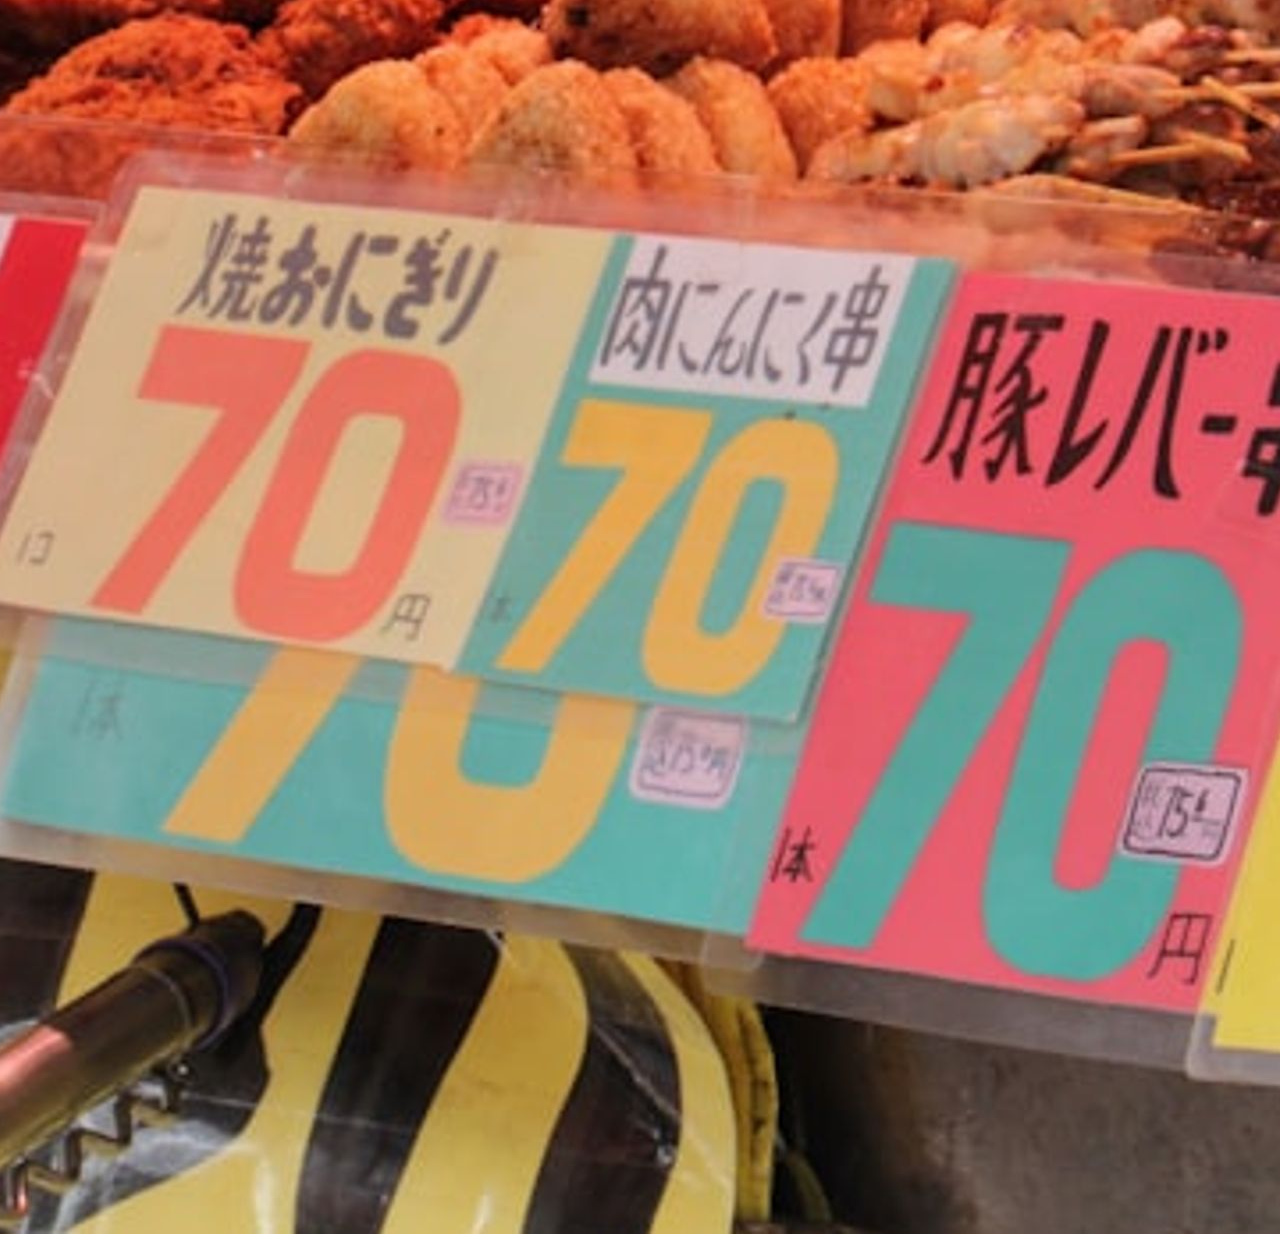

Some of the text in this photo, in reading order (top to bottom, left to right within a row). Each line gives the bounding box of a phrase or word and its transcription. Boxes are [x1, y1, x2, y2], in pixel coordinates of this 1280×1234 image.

[175, 213, 500, 346] 焼おにぎり
[599, 244, 891, 394] 肉にんにく串
[87, 323, 463, 643] 70
[494, 397, 841, 698] 70
[381, 591, 432, 642] 円
[796, 519, 1247, 983] 70
[1147, 910, 1213, 986] 円
